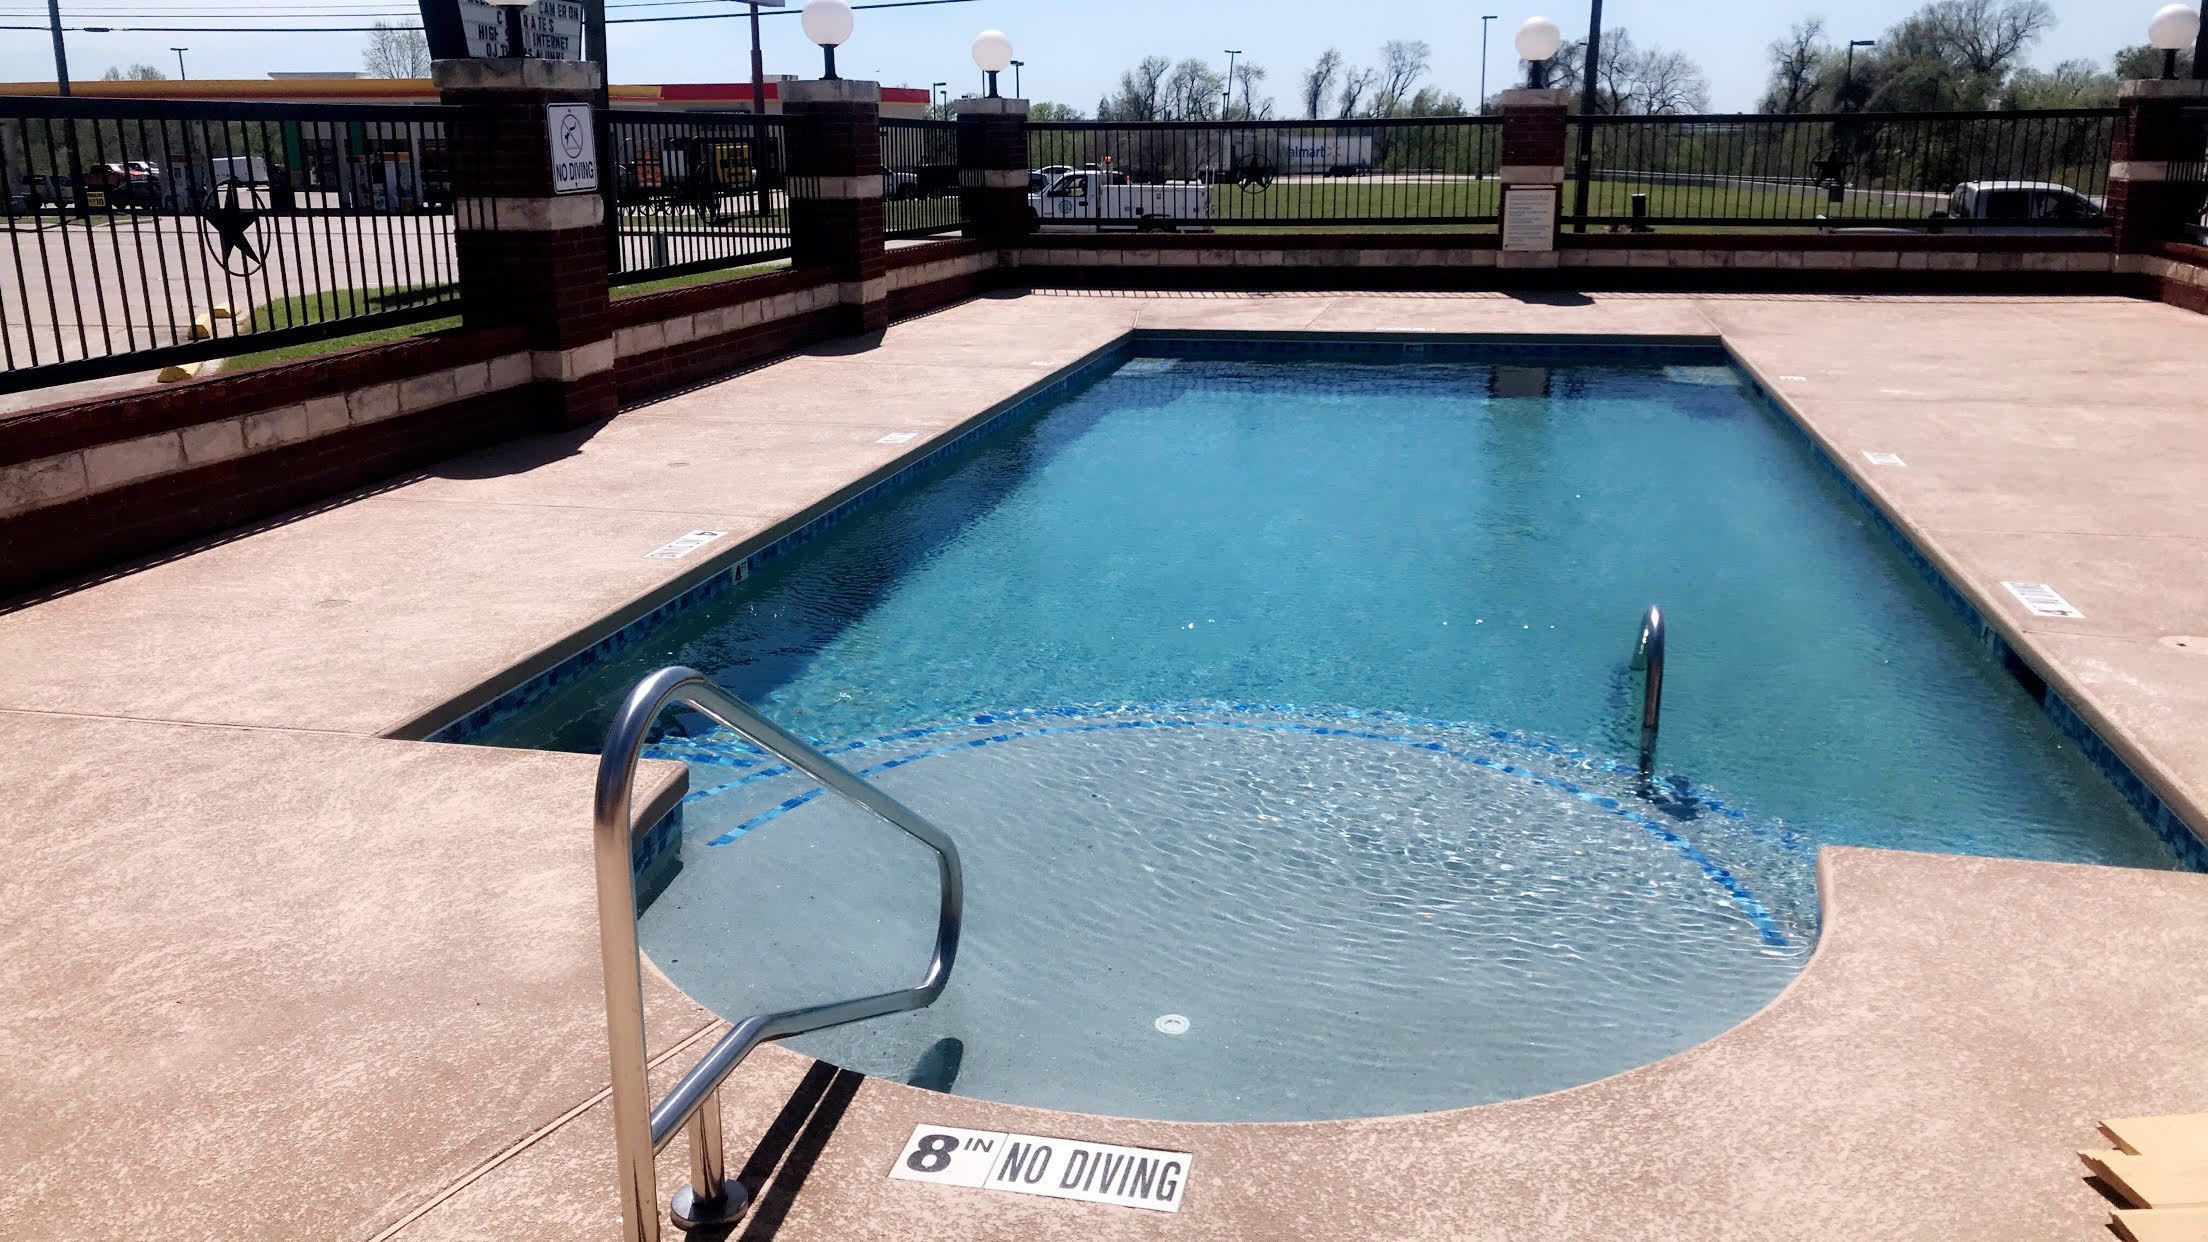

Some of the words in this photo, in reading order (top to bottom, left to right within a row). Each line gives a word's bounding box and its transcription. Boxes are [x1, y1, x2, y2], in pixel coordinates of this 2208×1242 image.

[539, 1, 579, 20] CAMERON
[522, 14, 554, 32] RATES
[532, 33, 569, 51] INTERNET
[555, 163, 568, 181] NO
[569, 161, 594, 180] DIVING
[906, 1134, 960, 1172] 8
[964, 1137, 995, 1152] IN
[997, 1142, 1053, 1184] NO
[1059, 1149, 1182, 1202] DIVING
